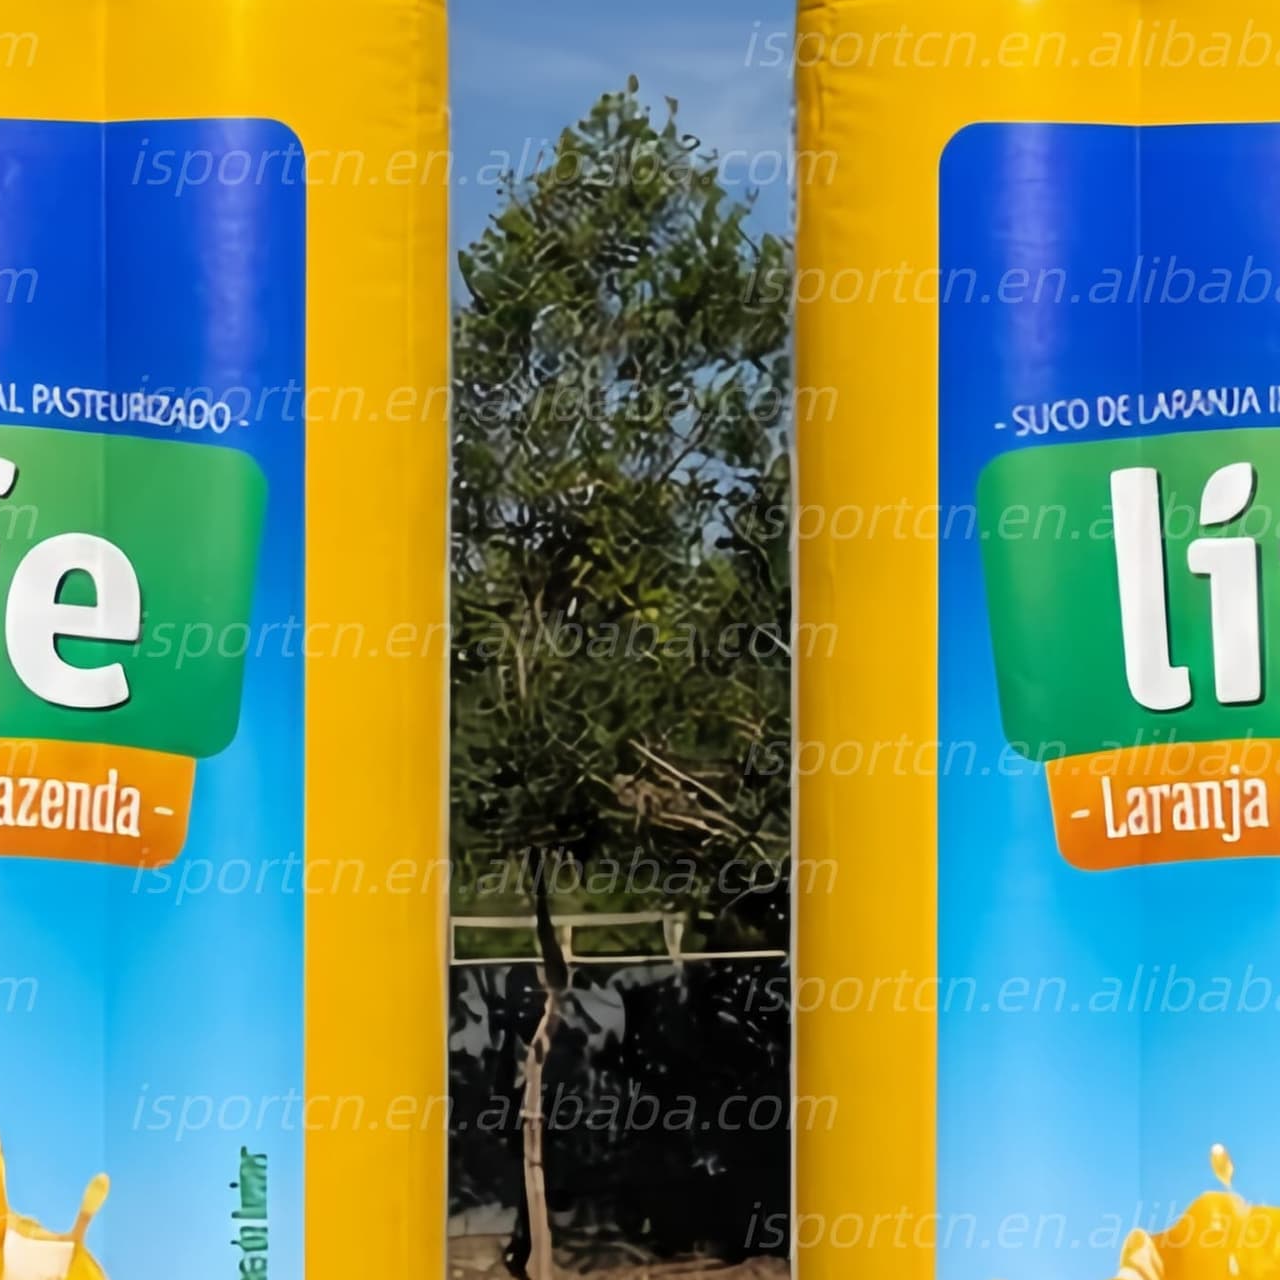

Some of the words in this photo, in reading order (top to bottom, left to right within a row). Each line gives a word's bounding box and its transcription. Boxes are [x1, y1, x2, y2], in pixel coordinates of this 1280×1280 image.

[32, 383, 232, 433] PASTEURIZADO
[1012, 398, 1090, 437] SUCO
[1097, 394, 1133, 428] DE
[1138, 386, 1261, 425] LARANJA
[1101, 764, 1270, 842] Laranja
